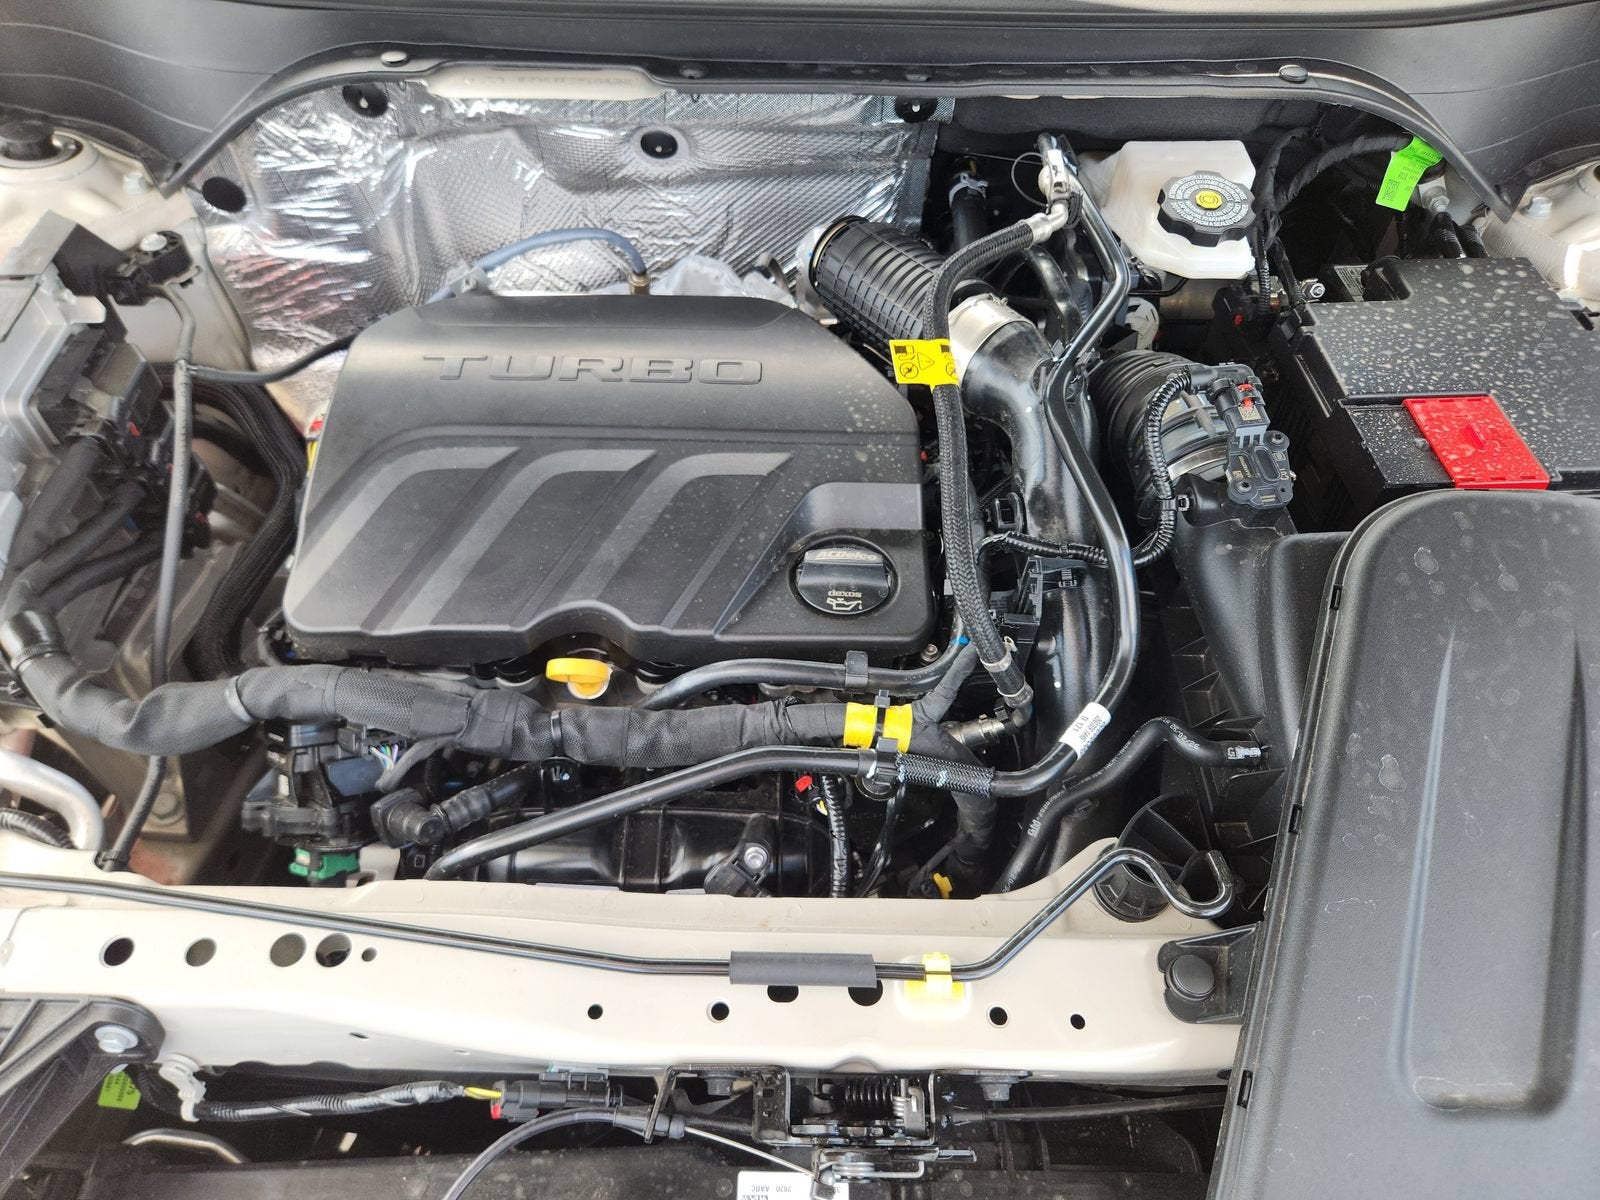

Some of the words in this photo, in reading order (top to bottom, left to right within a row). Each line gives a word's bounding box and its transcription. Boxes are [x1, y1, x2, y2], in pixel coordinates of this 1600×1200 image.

[423, 354, 763, 385] TURBO
[828, 589, 863, 598] dexos
[1026, 817, 1042, 838] GM
